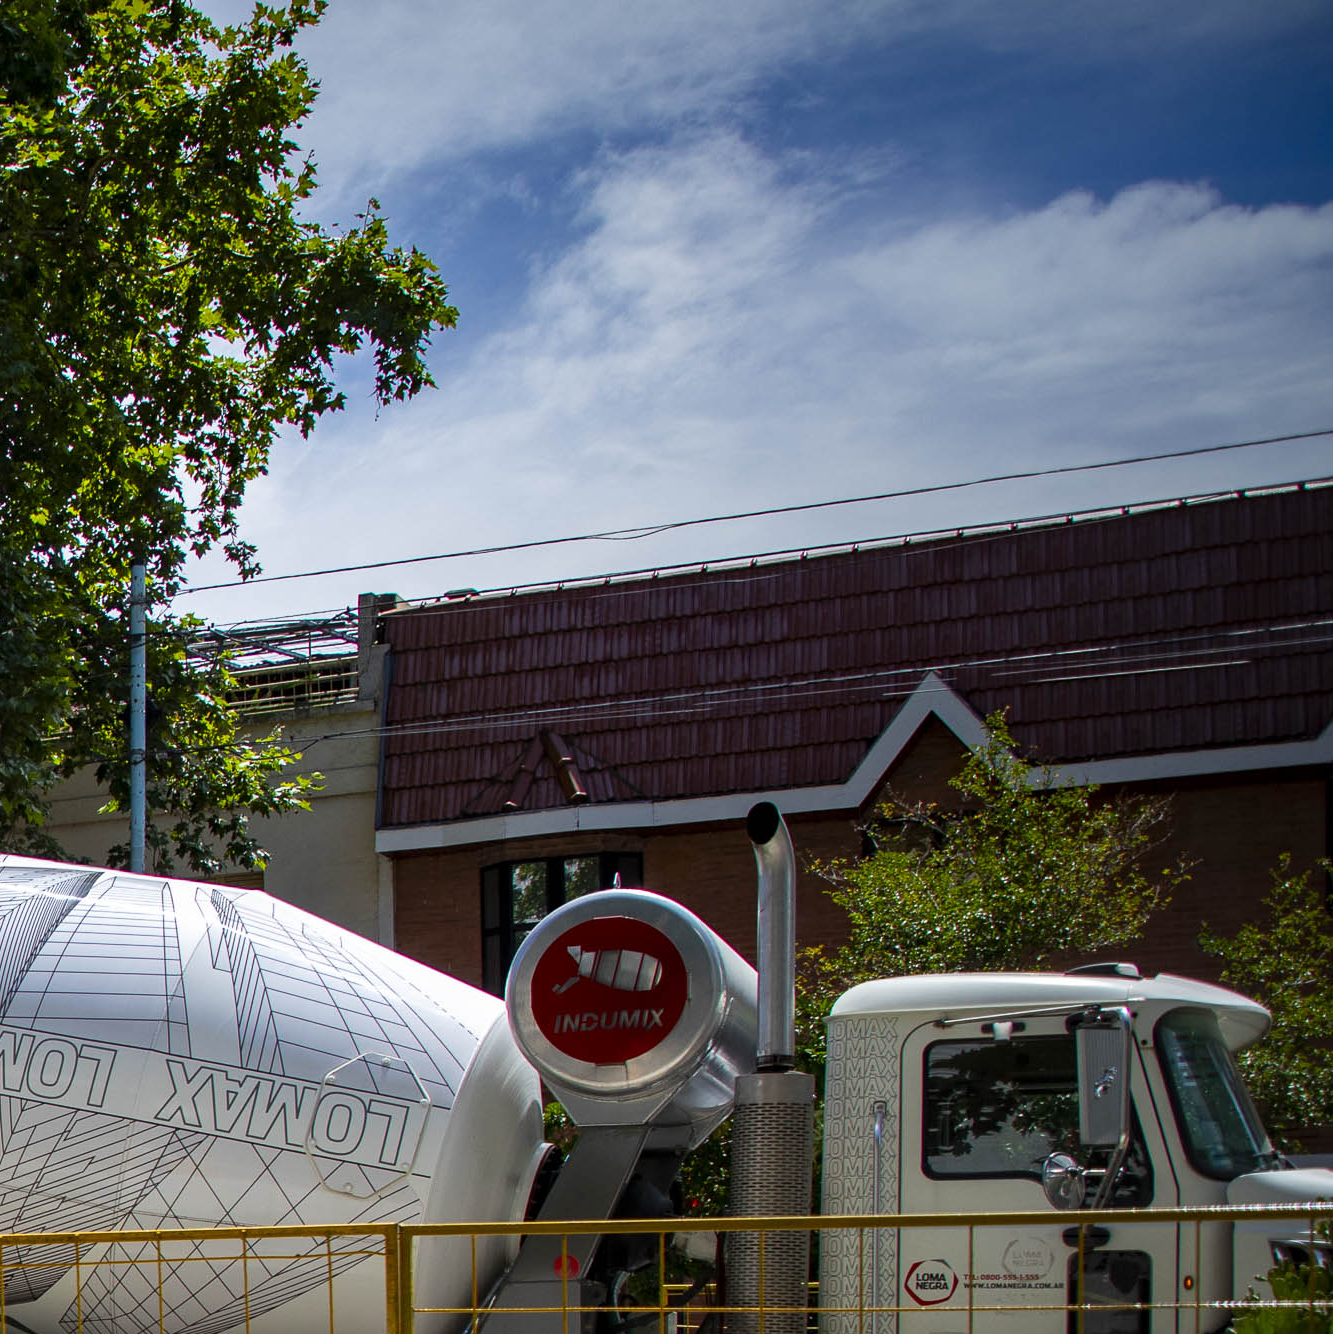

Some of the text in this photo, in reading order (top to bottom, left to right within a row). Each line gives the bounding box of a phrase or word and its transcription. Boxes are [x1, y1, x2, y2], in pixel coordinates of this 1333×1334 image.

[554, 1008, 664, 1033] INDUMIX
[154, 1058, 410, 1166] LOMAX
[916, 1272, 946, 1281] LOMA
[916, 1281, 949, 1290] NEGRA
